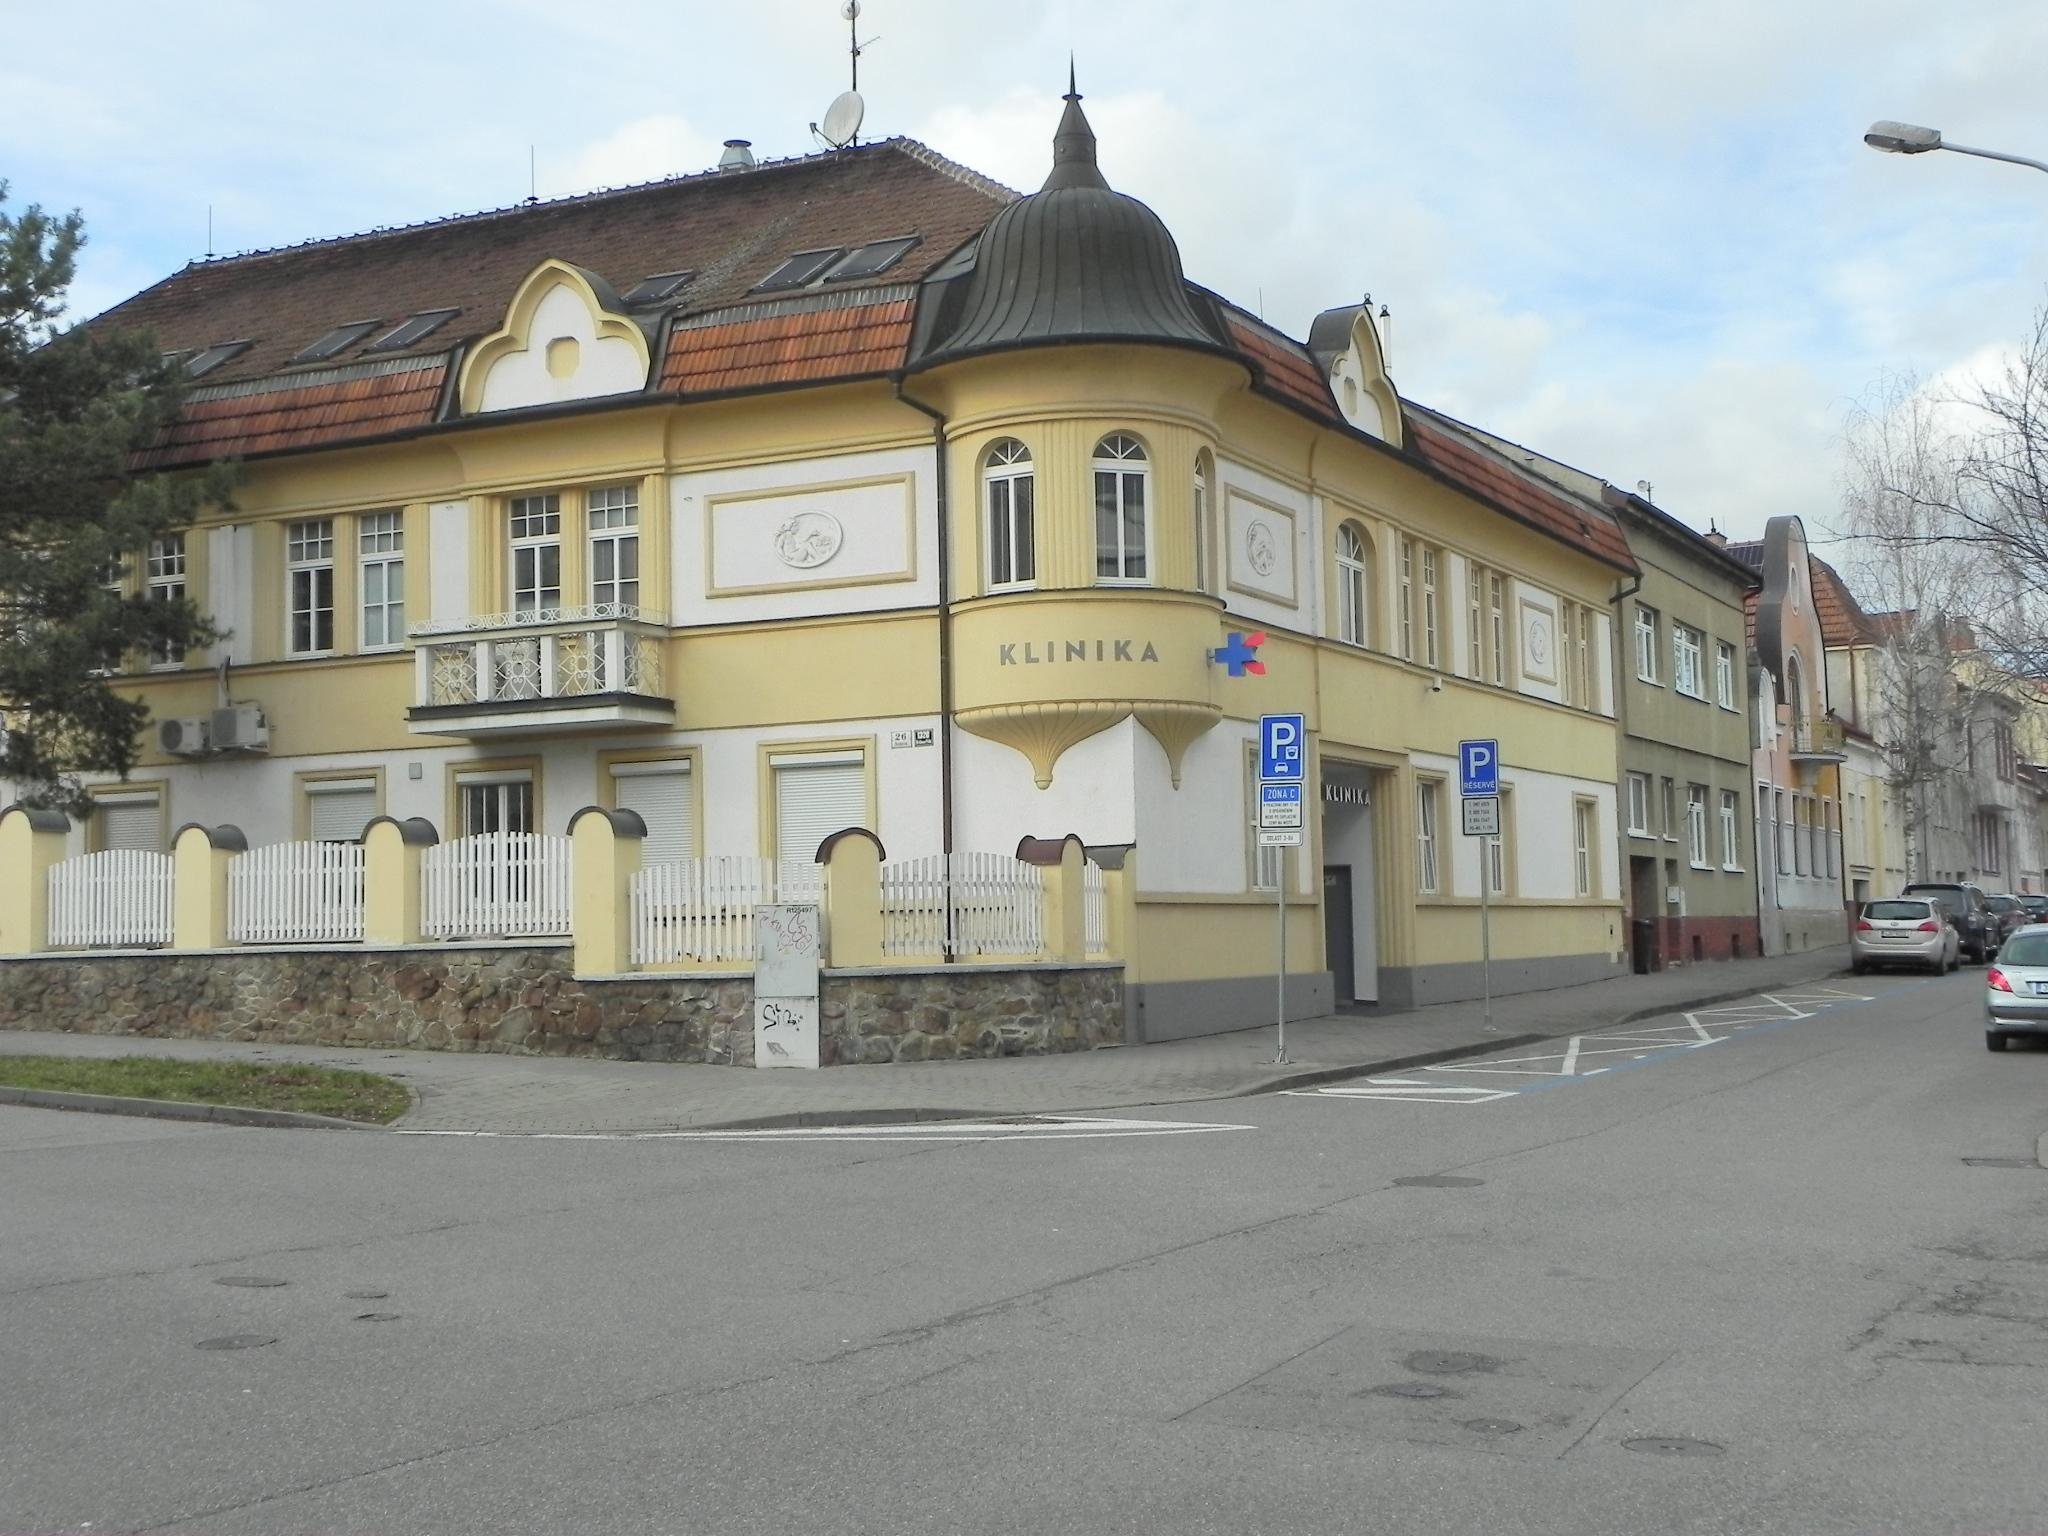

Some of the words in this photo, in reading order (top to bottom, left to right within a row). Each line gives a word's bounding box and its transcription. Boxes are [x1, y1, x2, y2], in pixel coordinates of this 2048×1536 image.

[999, 639, 1159, 666] KLINIKA
[895, 732, 907, 741] 26
[1270, 722, 1296, 760] P
[1469, 746, 1491, 779] P
[1290, 788, 1296, 799] C
[1325, 784, 1371, 806] KLINIKA
